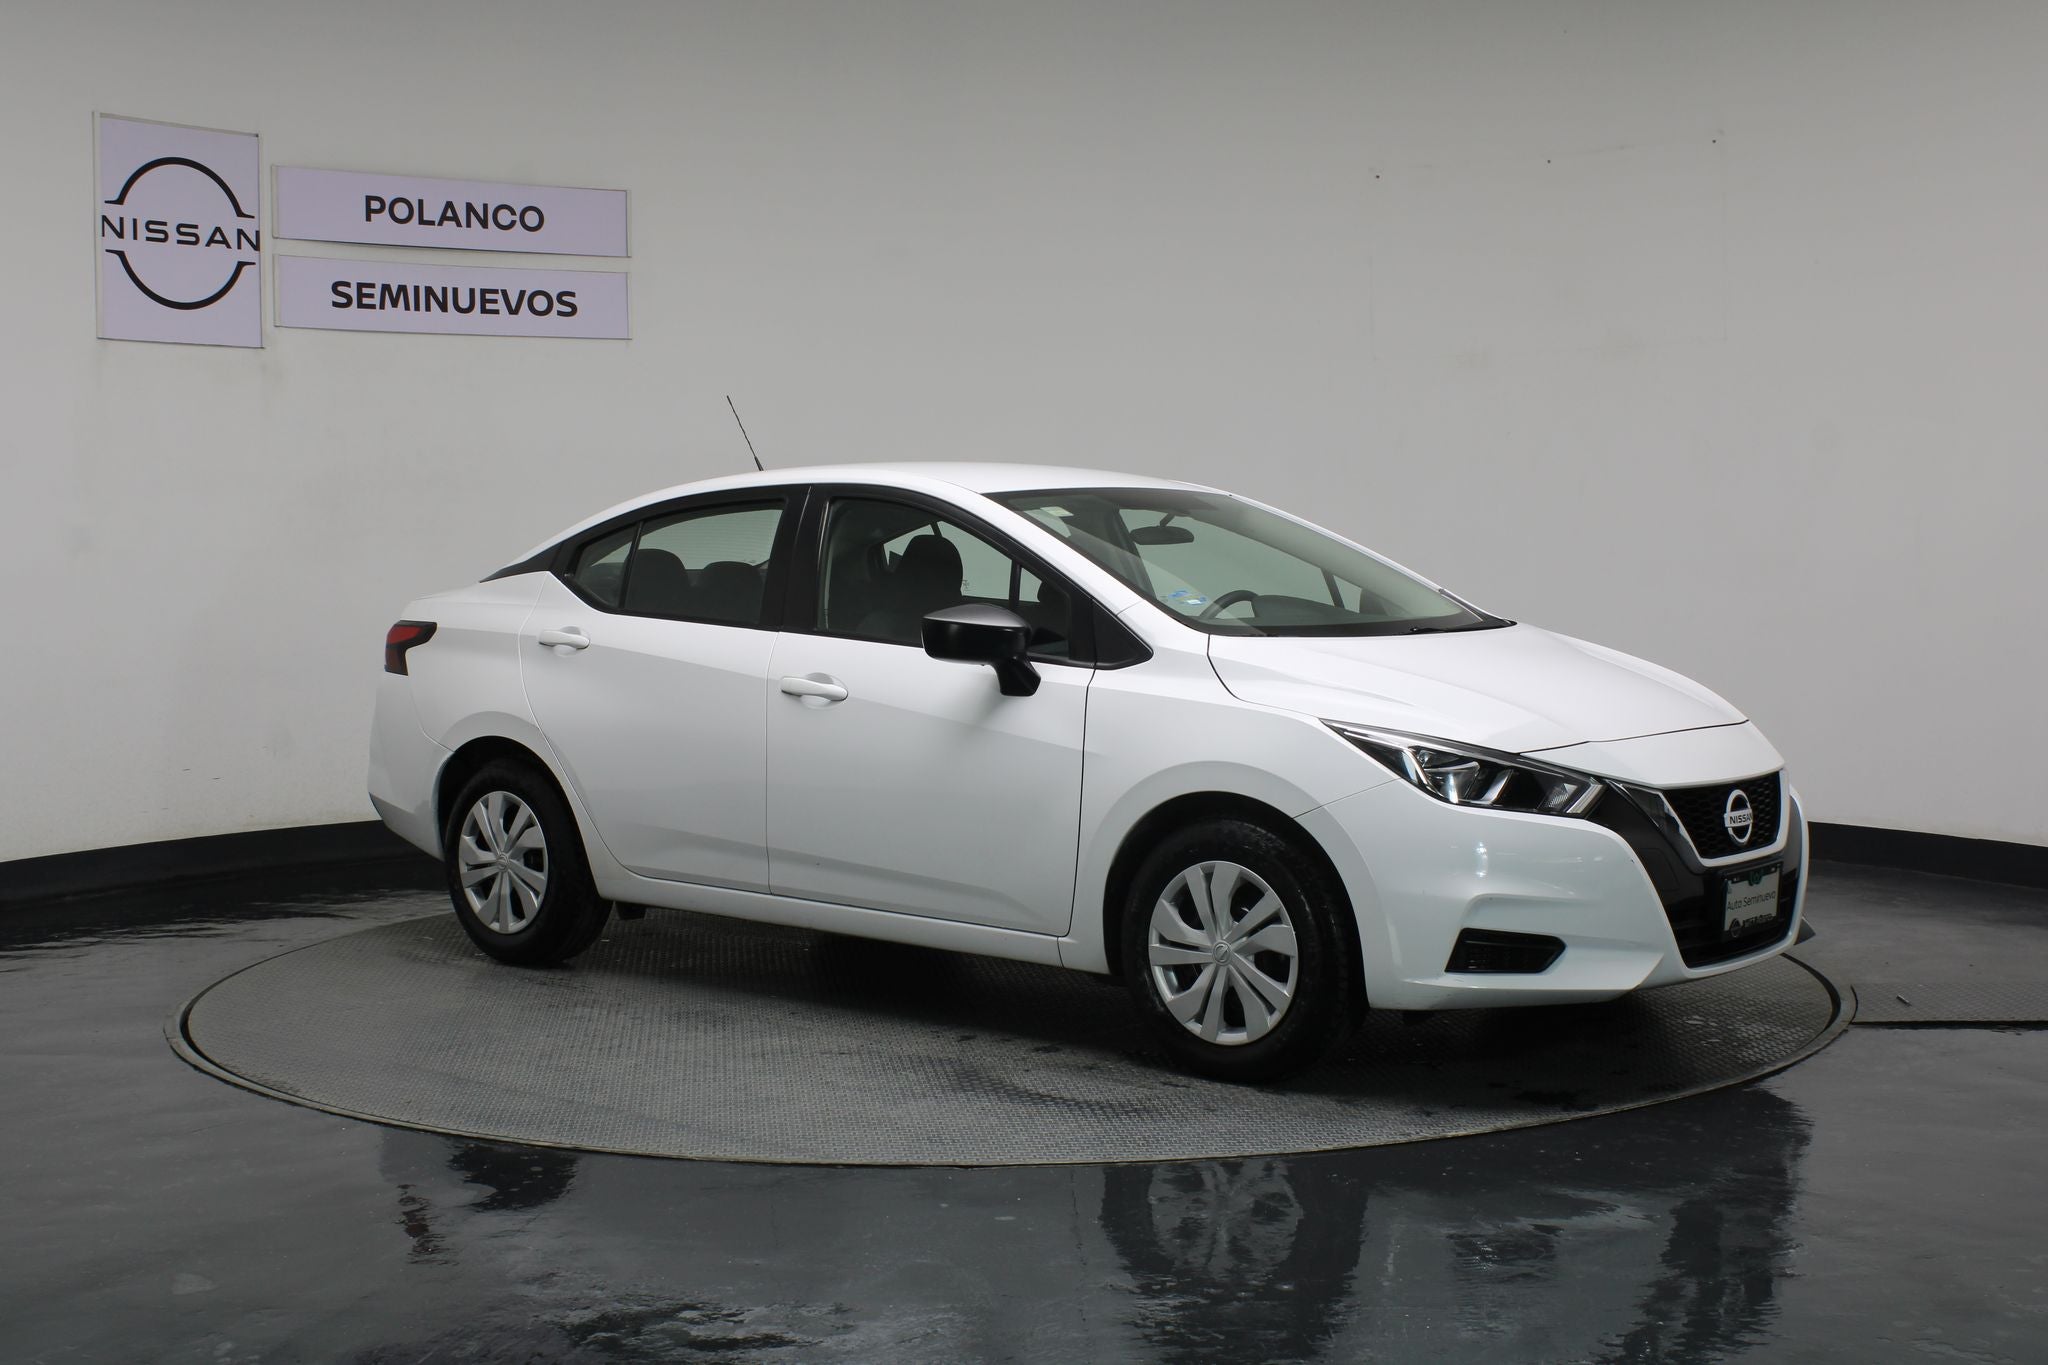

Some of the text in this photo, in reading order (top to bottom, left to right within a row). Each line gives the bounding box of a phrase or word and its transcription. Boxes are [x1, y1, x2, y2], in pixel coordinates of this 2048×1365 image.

[365, 194, 545, 233] POLANCO
[102, 214, 260, 252] NISSAN
[331, 280, 578, 318] SEMINUEVOS
[1727, 890, 1776, 911] Auto Seminuevo
